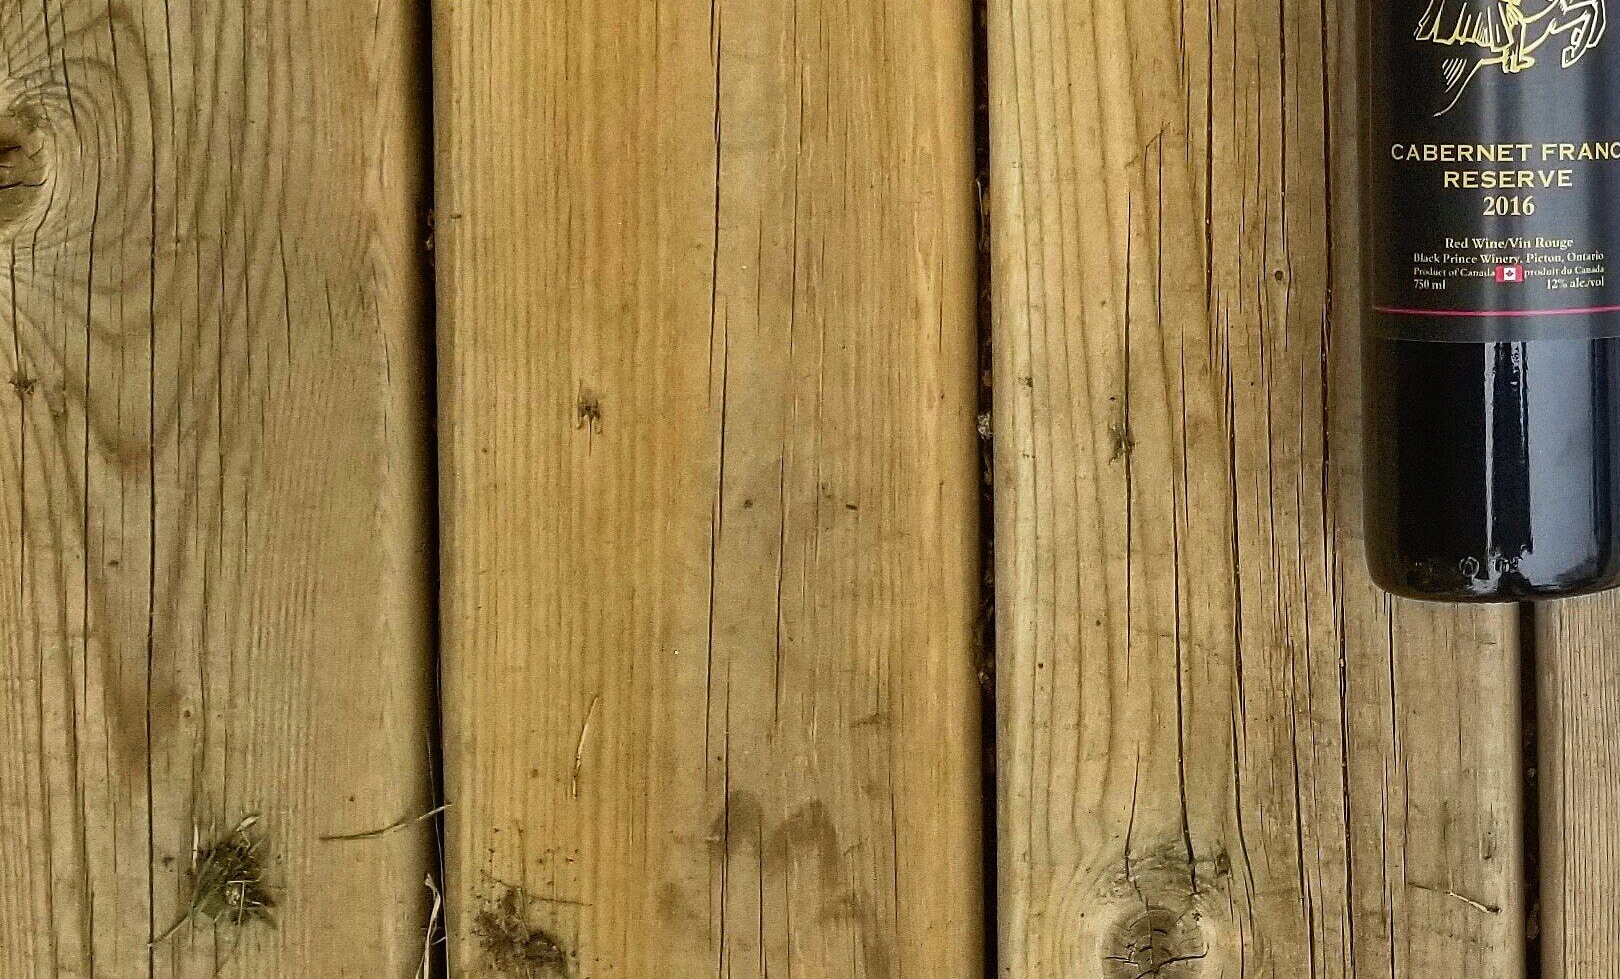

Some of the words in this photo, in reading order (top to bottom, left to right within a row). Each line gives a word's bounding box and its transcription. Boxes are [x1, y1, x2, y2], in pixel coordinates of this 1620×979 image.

[1391, 143, 1533, 162] CABERNET
[1443, 169, 1573, 189] RESERVE
[1483, 196, 1535, 216] 2016
[1445, 237, 1469, 249] Red
[1535, 236, 1574, 251] Rouge
[1413, 252, 1440, 263] Black
[1443, 253, 1478, 264] Prince
[1567, 250, 1604, 262] Ontario
[1413, 267, 1446, 277] Product
[1460, 268, 1495, 277] Canada
[1575, 264, 1605, 275] Canada
[1413, 279, 1430, 290] 750
[1431, 279, 1446, 290] ml
